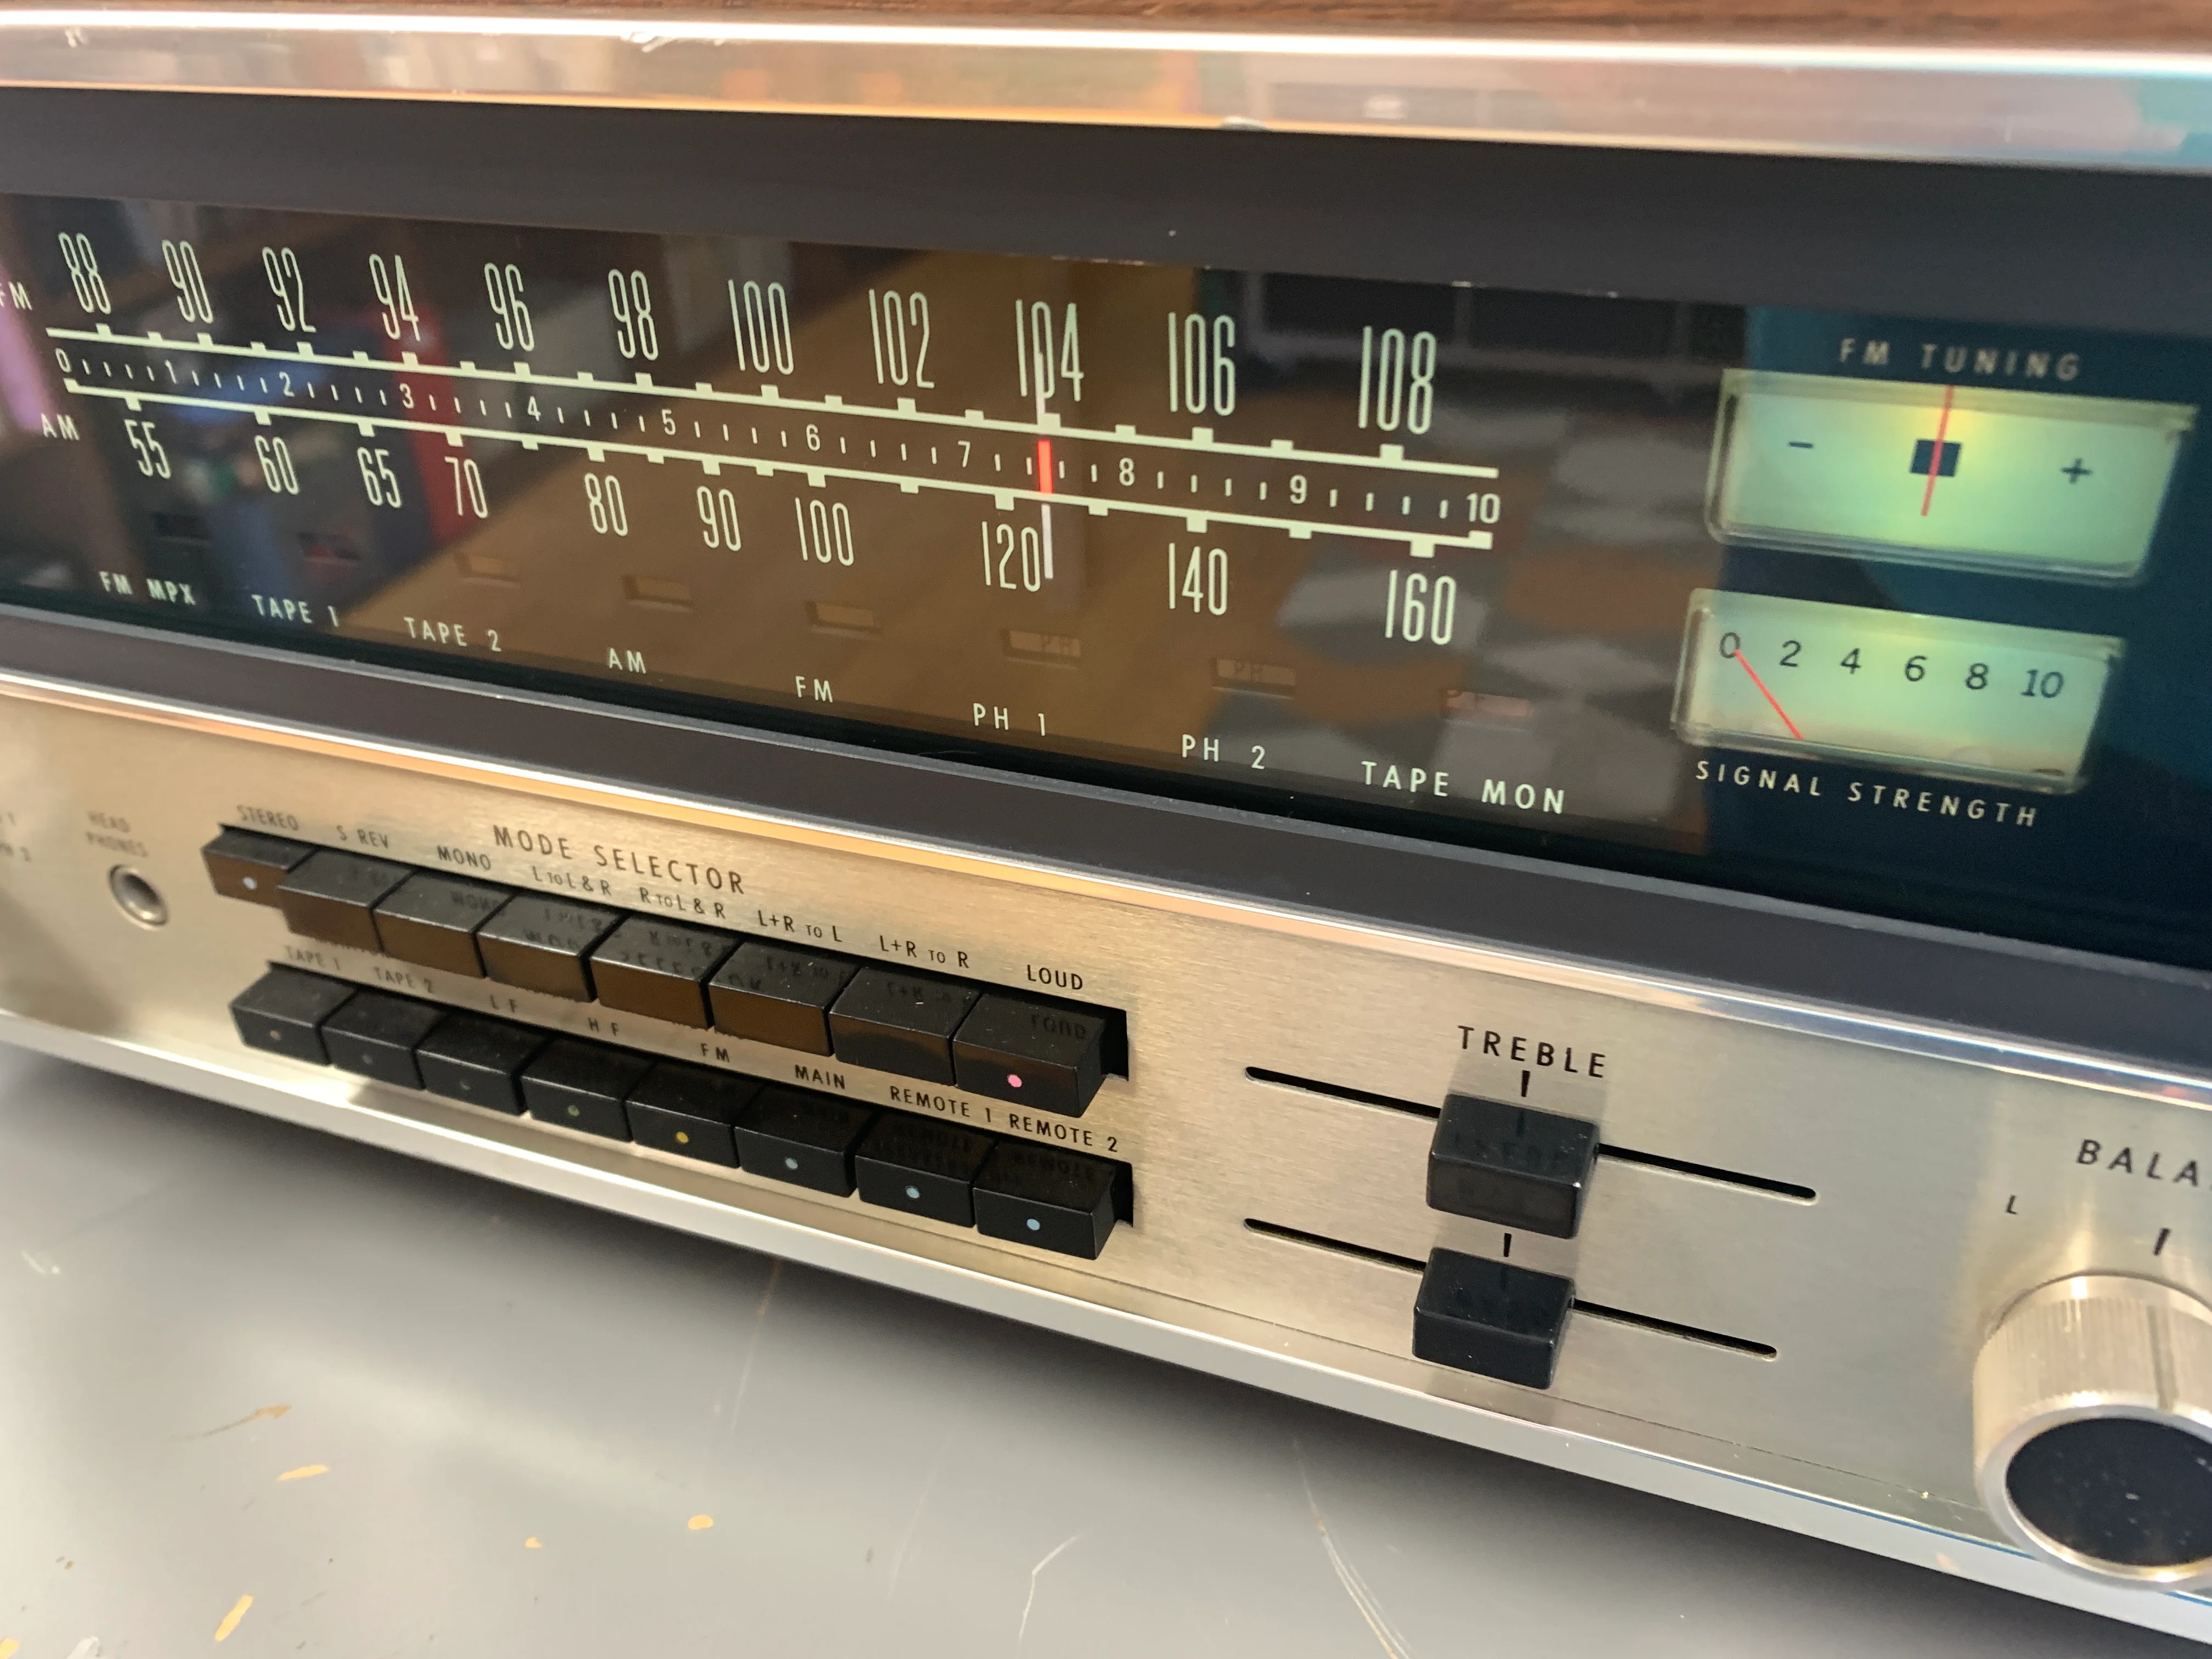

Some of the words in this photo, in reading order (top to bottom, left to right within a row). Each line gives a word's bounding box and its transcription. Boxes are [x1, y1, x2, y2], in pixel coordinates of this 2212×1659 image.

[58, 232, 111, 314] 88
[162, 239, 213, 324] 90
[262, 247, 317, 332] 92
[369, 253, 421, 342] 94
[484, 263, 535, 352] 96
[608, 269, 659, 361] 98
[727, 279, 794, 376] 100
[868, 288, 935, 389] 102
[1015, 298, 1085, 403] 104
[1167, 312, 1236, 417] 106
[1358, 325, 1437, 435] 108
[1839, 338, 1891, 366] FM
[1921, 343, 2081, 382] TUNING
[41, 412, 80, 440] AM
[55, 347, 72, 373] 0
[166, 360, 178, 384] 1
[279, 372, 295, 397] 2
[399, 383, 415, 408] 3
[527, 396, 541, 422] 4
[662, 409, 677, 436] 5
[805, 424, 821, 452] 6
[957, 441, 972, 468] 7
[1119, 458, 1135, 486] 8
[1290, 475, 1307, 504] 9
[1466, 493, 1500, 524] 10
[124, 419, 171, 479] 55
[254, 435, 300, 495] 60
[358, 447, 402, 508] 65
[445, 456, 488, 520] 70
[584, 472, 629, 537] 80
[696, 486, 742, 552] 90
[795, 497, 855, 566] 100
[981, 521, 1041, 592] 120
[1168, 542, 1228, 616] 140
[1385, 569, 1457, 646] 160
[99, 571, 133, 596] FM
[147, 578, 198, 606] MPX
[252, 594, 313, 624] TAPE
[328, 606, 341, 627] 1
[403, 617, 468, 647] TAPE
[488, 630, 501, 652] 2
[608, 648, 647, 674] AM
[1719, 631, 1741, 659] 0
[1780, 640, 1803, 668] 2
[1841, 648, 1861, 675] 4
[1904, 654, 1927, 682] 6
[1965, 663, 1990, 691] 8
[2020, 669, 2064, 699] 10
[795, 676, 833, 703] FM
[973, 702, 1009, 731] PH
[1037, 713, 1046, 737] 1
[1181, 733, 1219, 762] PH
[1251, 745, 1265, 769] 2
[1361, 760, 1449, 797] TAPE
[1481, 778, 1565, 814] MON
[1695, 759, 1822, 797] SIGNAL
[1847, 781, 2039, 828] STRENGTH
[87, 811, 131, 833] HEAD
[236, 804, 300, 832] STEREO
[85, 831, 149, 858] PHONES
[336, 825, 348, 843] S
[357, 828, 390, 850] REV
[436, 845, 493, 871] MONO
[493, 825, 573, 860] MODE
[593, 844, 745, 895] SELECTOR
[284, 945, 325, 968] TAPE
[957, 951, 969, 969] R
[373, 965, 416, 989] TAPE
[1026, 964, 1084, 991] LOUD
[1457, 1025, 1607, 1079] TREBLE
[794, 1064, 847, 1090] MAIN
[889, 1085, 972, 1118] REMOTE
[1009, 1113, 1094, 1147] REMOTE
[1107, 1136, 1119, 1153] 2
[2075, 1138, 2212, 1190] BALA
[2005, 1194, 2019, 1215] L
